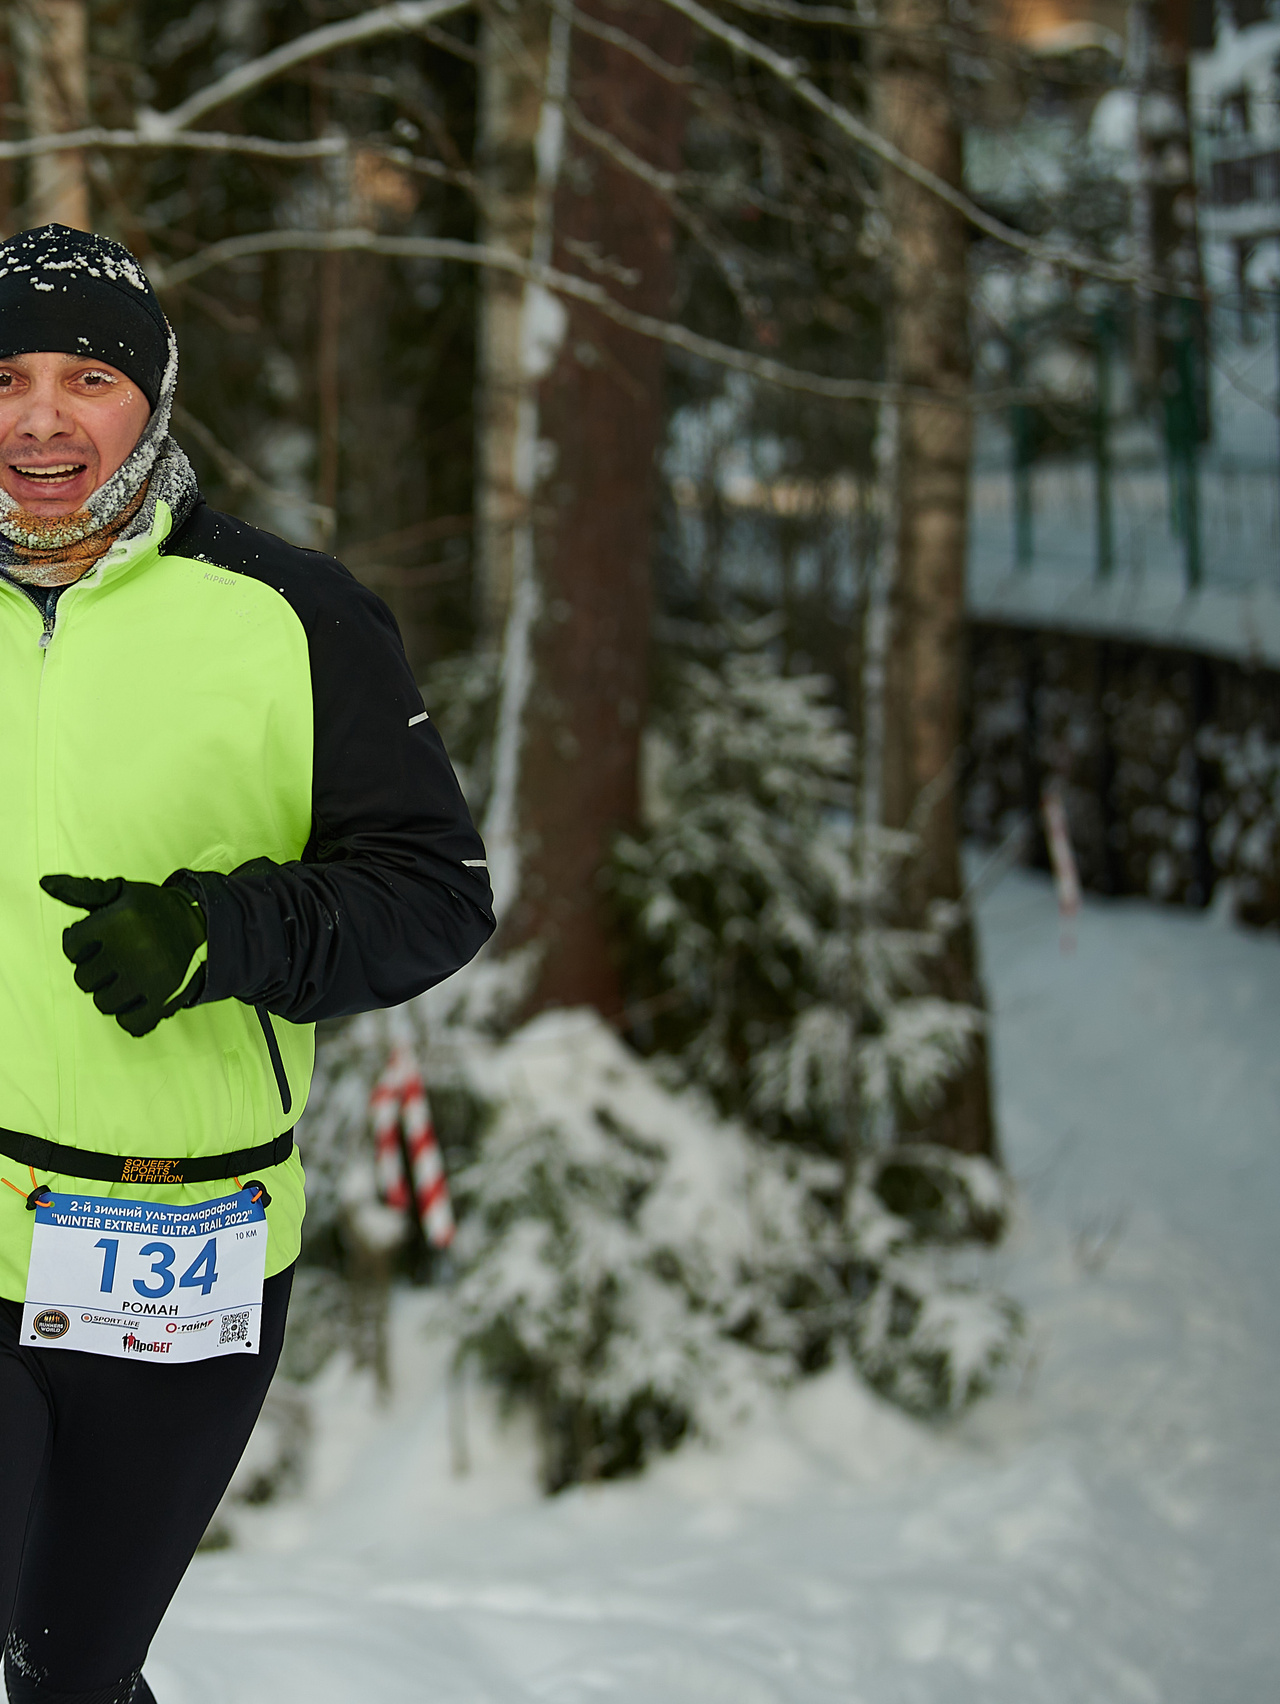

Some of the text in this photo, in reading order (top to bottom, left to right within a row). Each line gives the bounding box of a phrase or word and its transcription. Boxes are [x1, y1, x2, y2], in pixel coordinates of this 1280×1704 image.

[204, 573, 236, 585] KIPRUN
[124, 1158, 180, 1168] SQUEEZY
[122, 1165, 170, 1175] SPORTS
[120, 1173, 184, 1183] NUTRITION
[70, 1200, 238, 1224] 2-й зимний ультрамарафон
[51, 1210, 253, 1236] "WINTER EXTREME ULTRA TRAIL 2022"
[235, 1231, 244, 1240] 10
[94, 1237, 219, 1299] 134
[121, 1301, 179, 1316] РОМАН
[93, 1315, 122, 1324] SPORT
[132, 1339, 173, 1354] ПроБЕГ
